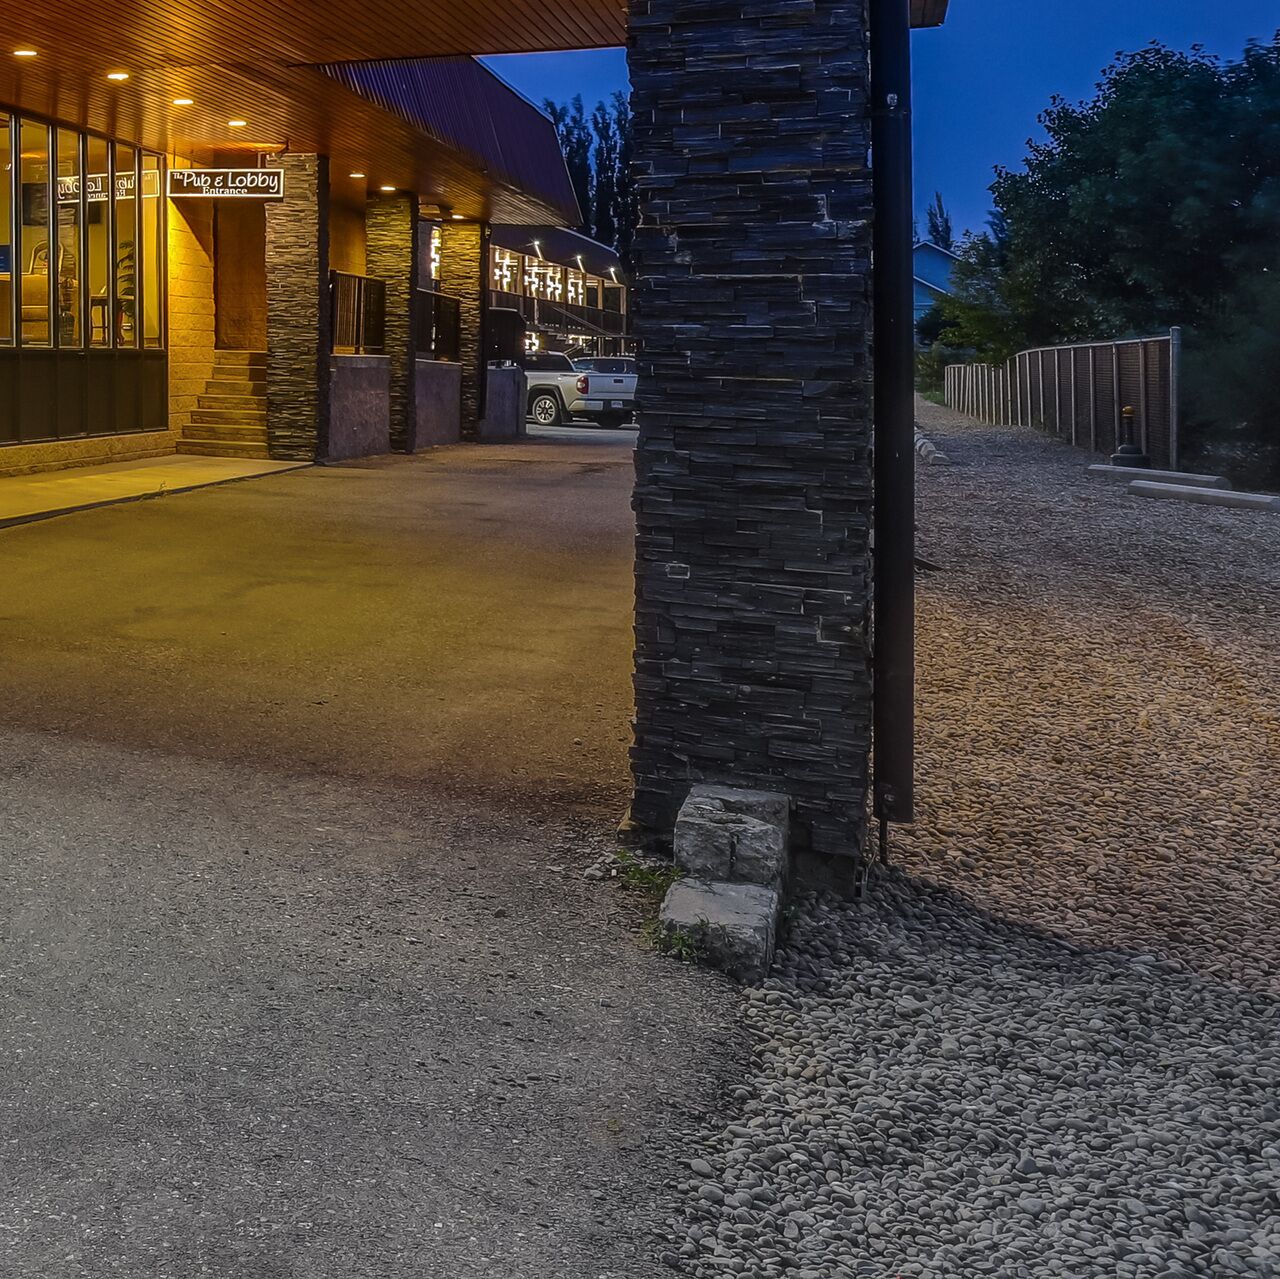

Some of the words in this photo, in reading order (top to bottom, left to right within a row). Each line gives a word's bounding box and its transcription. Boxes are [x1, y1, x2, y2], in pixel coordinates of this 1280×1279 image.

[182, 171, 211, 187] Pub
[214, 175, 224, 187] &
[228, 172, 278, 193] Lobby
[202, 186, 248, 195] Entrance
